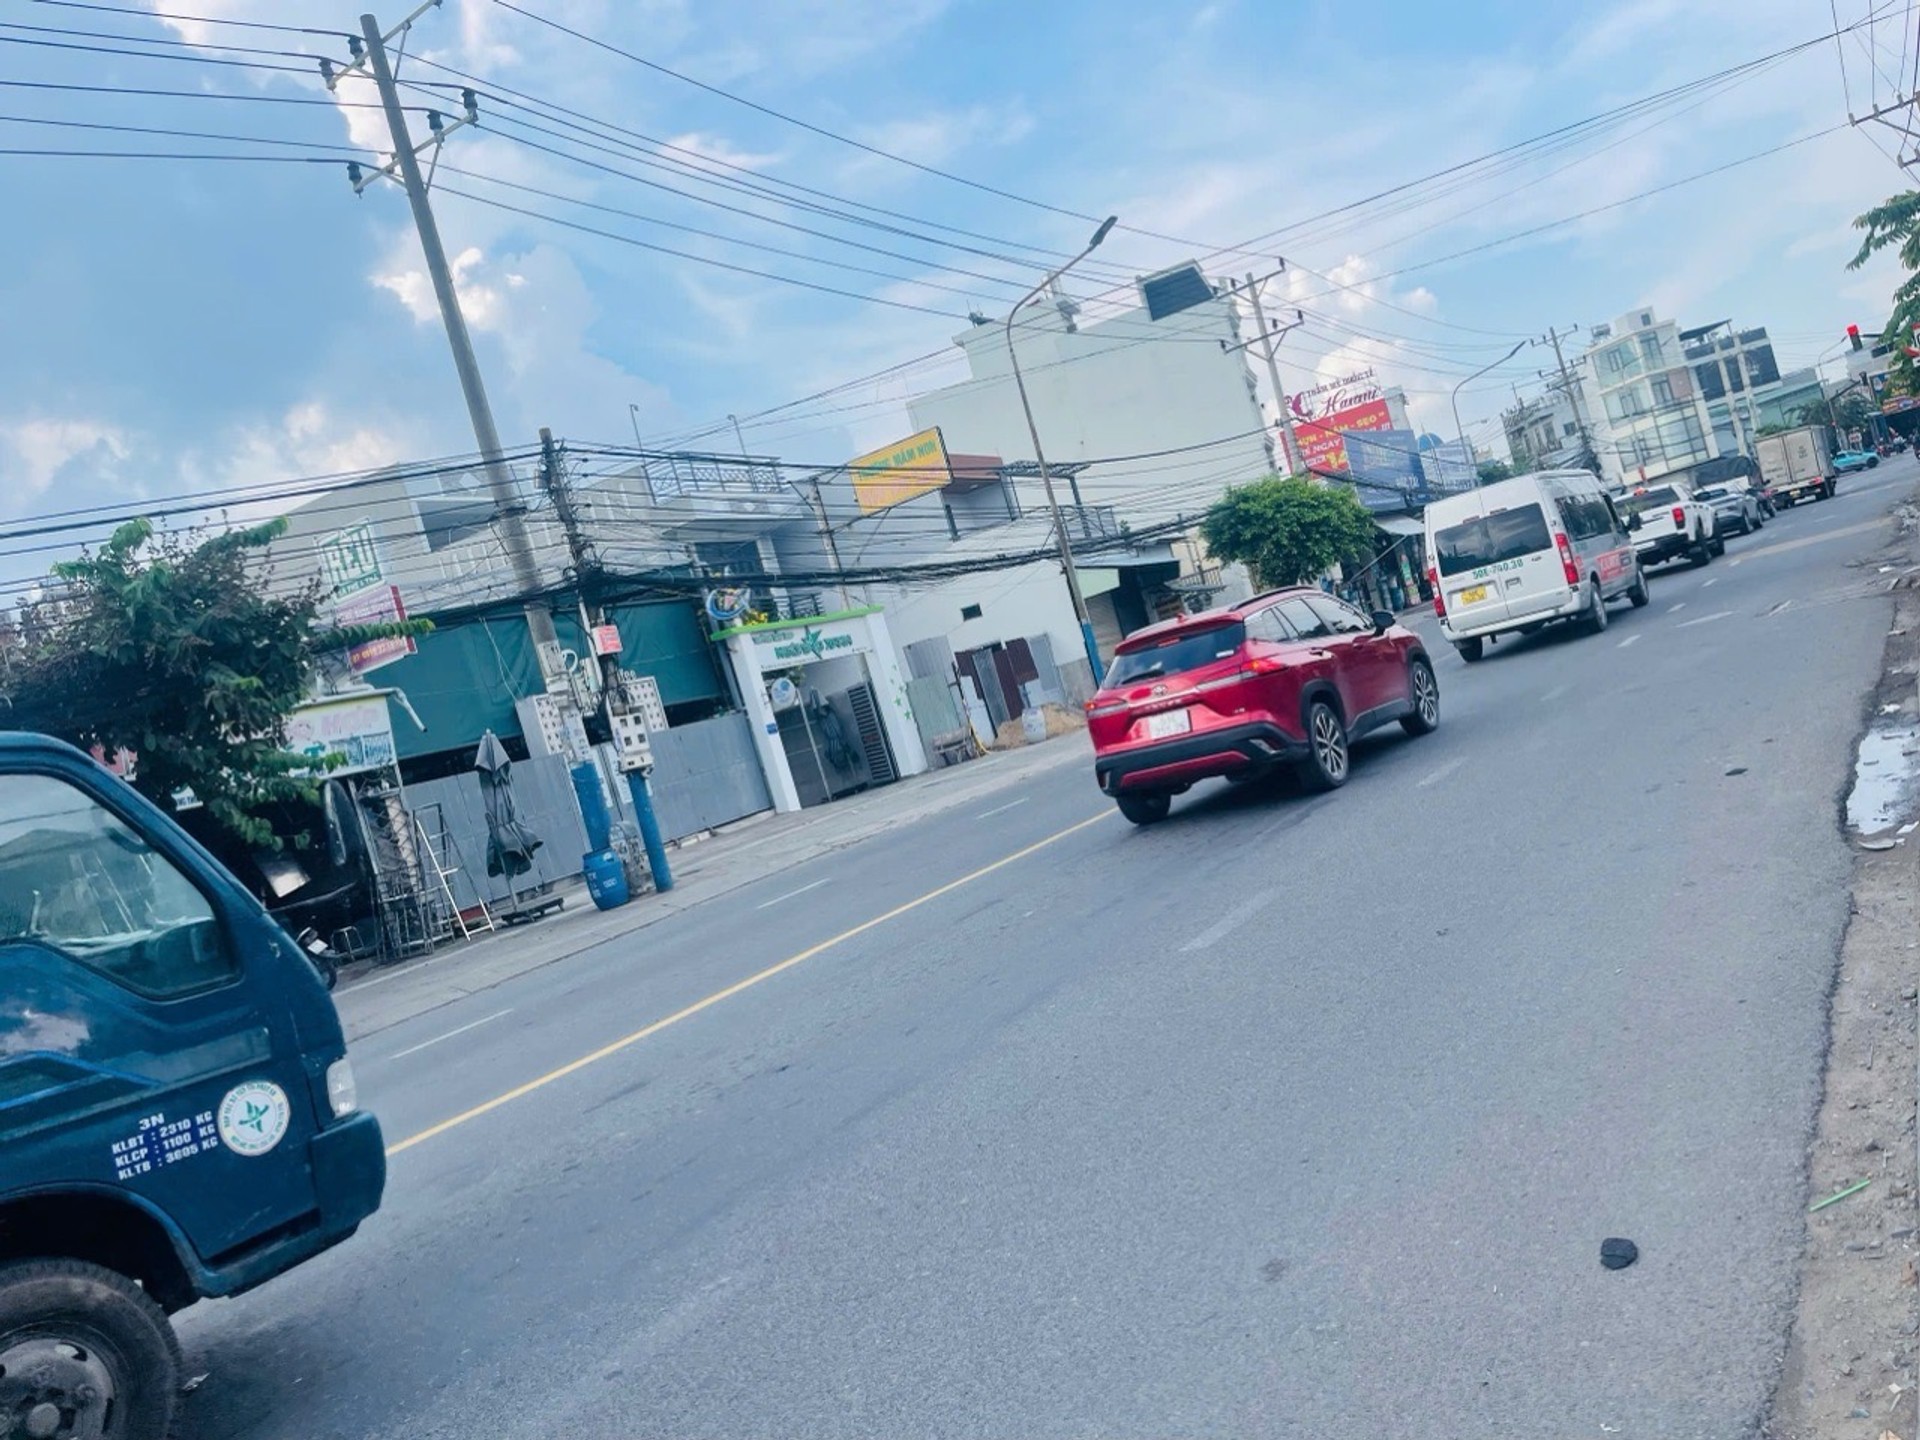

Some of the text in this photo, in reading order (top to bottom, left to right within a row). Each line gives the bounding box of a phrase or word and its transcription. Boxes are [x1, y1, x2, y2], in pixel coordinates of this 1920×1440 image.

[111, 1133, 145, 1154] KLBT
[160, 1119, 191, 1138] 2310
[195, 1110, 213, 1125] KG
[139, 1113, 165, 1131] 3N
[115, 1147, 148, 1168] KLCP
[162, 1132, 191, 1149] 1100
[199, 1123, 216, 1139] KG
[118, 1160, 152, 1181] KLTB
[202, 1136, 219, 1152] KG
